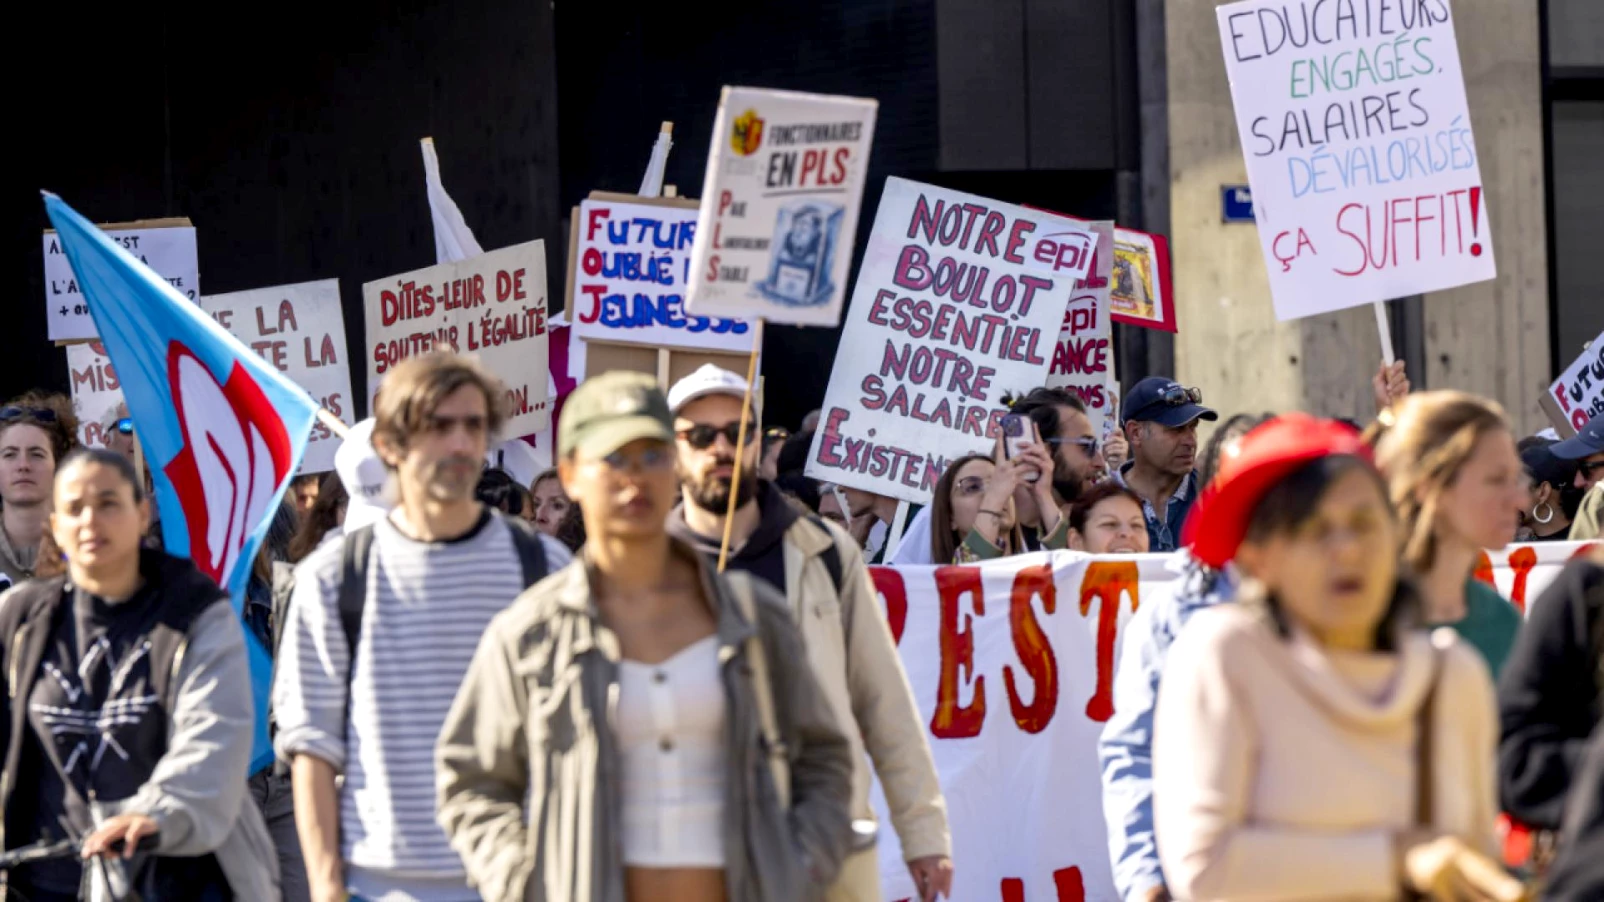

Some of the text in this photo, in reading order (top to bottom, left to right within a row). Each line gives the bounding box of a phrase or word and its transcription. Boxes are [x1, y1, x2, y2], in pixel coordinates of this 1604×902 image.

[1251, 88, 1429, 156] SALAIRES
[766, 151, 797, 188] EN
[799, 147, 850, 188] PLS
[1288, 115, 1474, 198] DÉVALORISÉS
[907, 193, 1036, 265] NOTRE
[1033, 239, 1090, 271] epi
[1272, 186, 1483, 276] ÇA SUFFIT!
[496, 268, 527, 302] DE
[893, 244, 1053, 318] BOULOT
[255, 299, 299, 336] LA
[303, 332, 338, 368] LA
[879, 338, 996, 401] NOTRE
